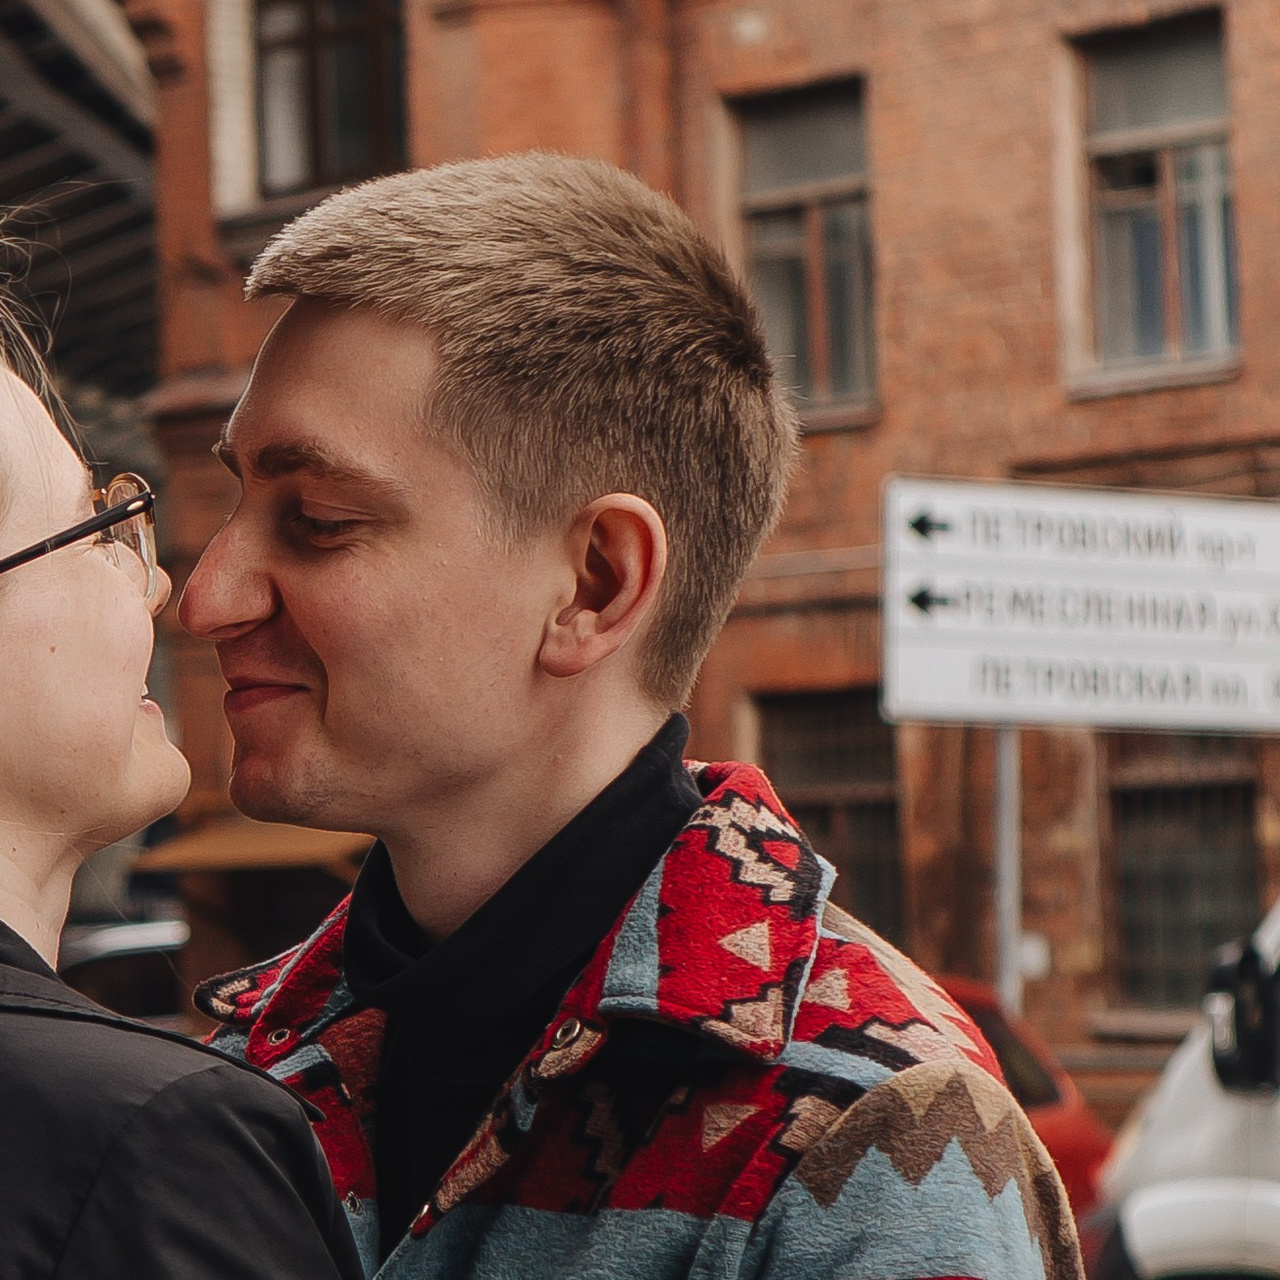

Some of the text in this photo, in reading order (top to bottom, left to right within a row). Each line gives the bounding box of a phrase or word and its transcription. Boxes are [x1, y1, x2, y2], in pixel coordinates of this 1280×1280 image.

[968, 507, 1186, 557] ПЕТРОВСКИЙ
[963, 583, 1216, 632] РЕМЕСЛЕННАЯ
[974, 657, 1201, 705] ПЕТРОВСКАЯ
